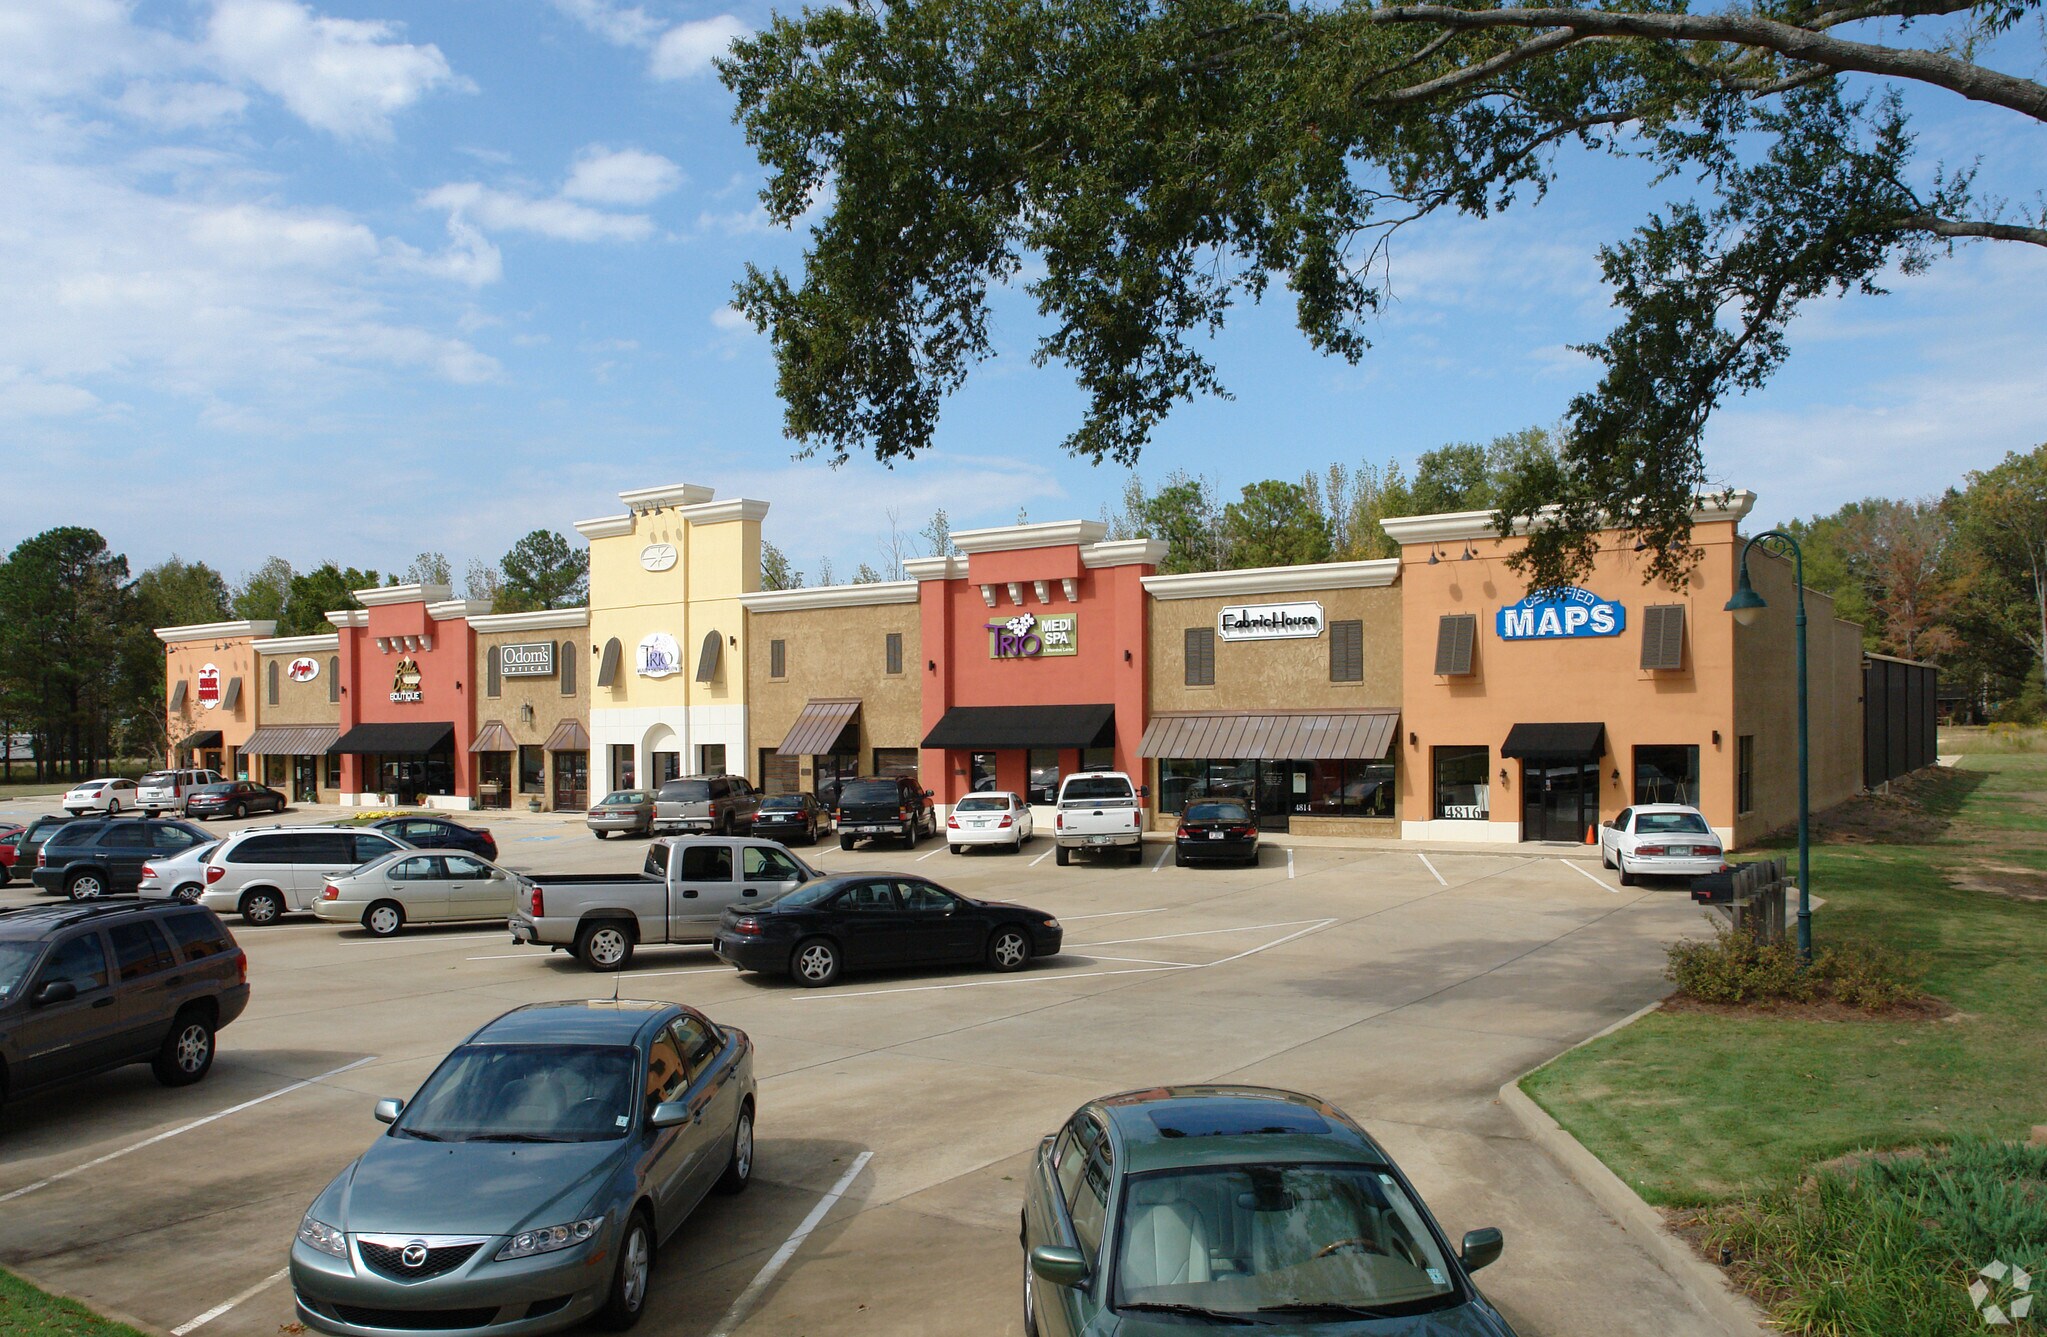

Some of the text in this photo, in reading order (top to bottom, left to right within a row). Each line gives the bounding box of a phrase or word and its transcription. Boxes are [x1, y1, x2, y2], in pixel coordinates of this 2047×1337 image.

[1041, 618, 1072, 632] MEDI
[1504, 604, 1615, 637] MAPS
[1045, 631, 1069, 644] SPA
[503, 646, 549, 664] Odom's
[503, 665, 549, 673] OPTICAL
[390, 691, 421, 702] BOUTIQUE
[1295, 803, 1312, 812] 4814
[1446, 806, 1481, 819] 4816
